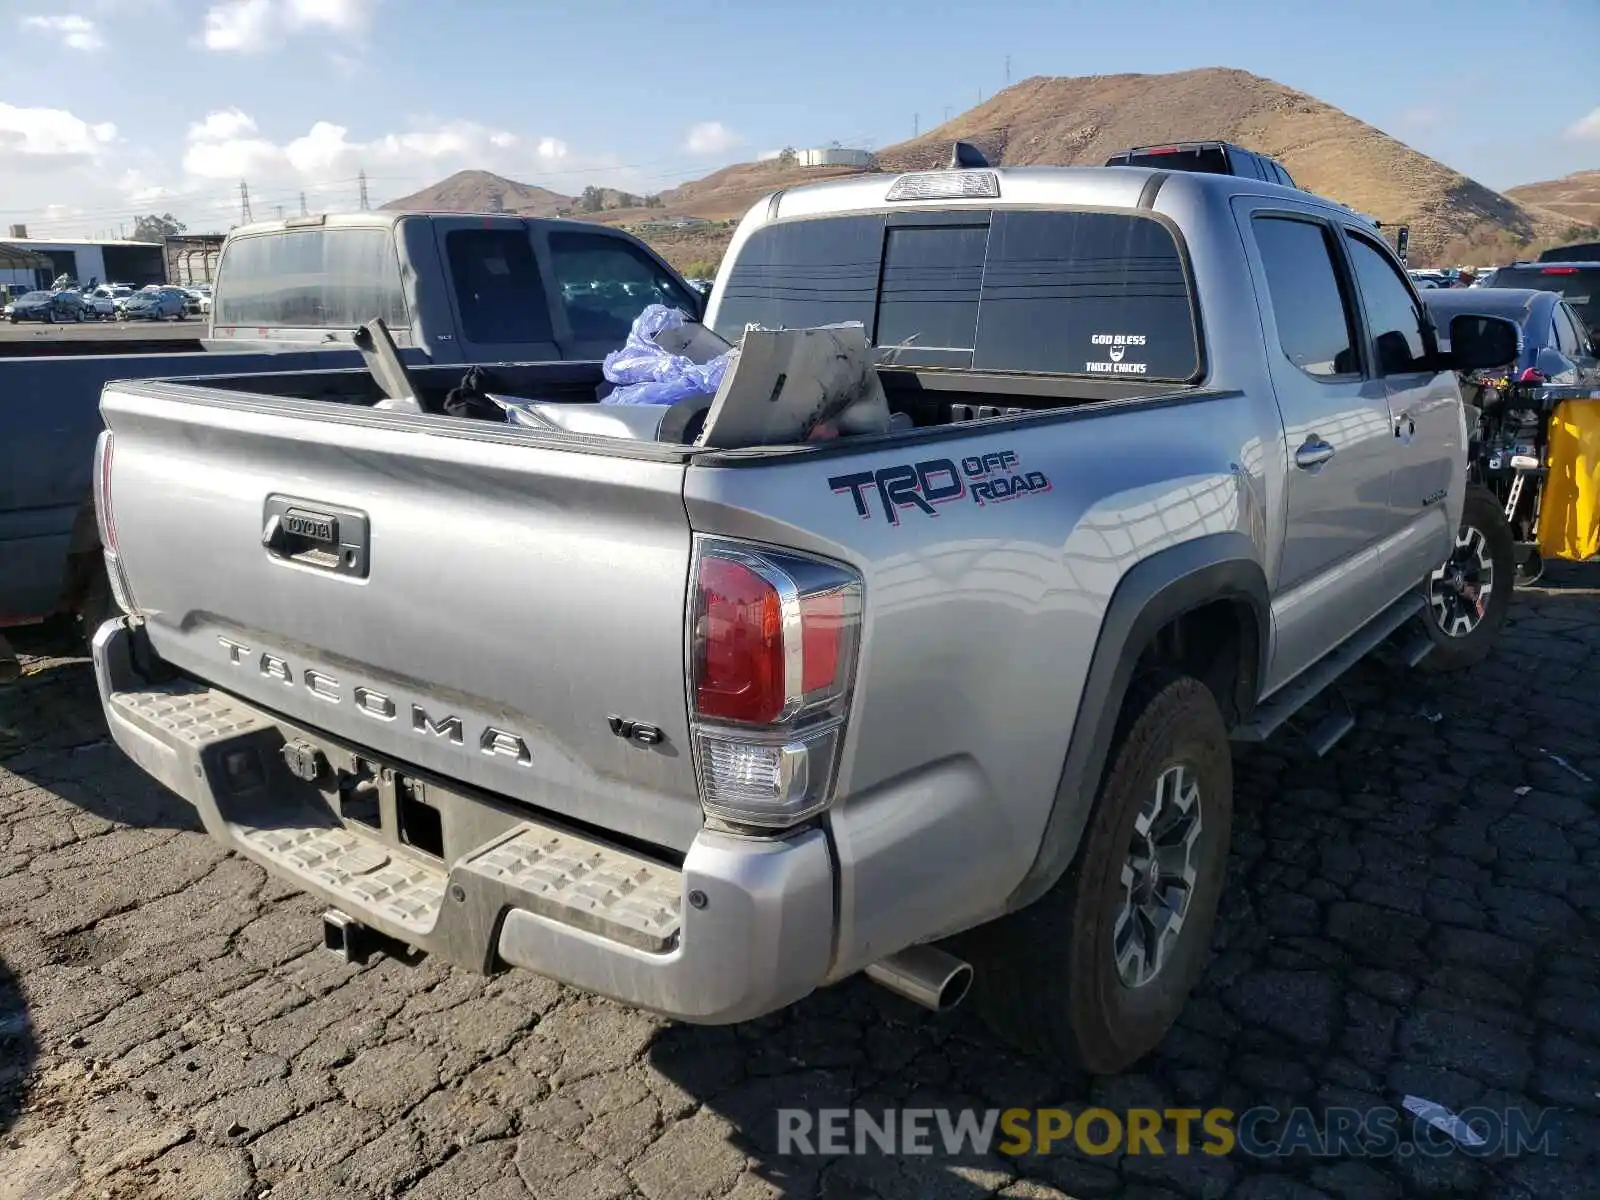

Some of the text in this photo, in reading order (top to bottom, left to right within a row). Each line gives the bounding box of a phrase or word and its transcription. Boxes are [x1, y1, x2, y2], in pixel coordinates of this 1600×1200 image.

[1091, 334, 1146, 346] GOD BLESS
[1113, 363, 1147, 373] CHICKS
[828, 450, 1019, 526] TRD OFF
[969, 471, 1053, 507] ROAD
[286, 519, 332, 539] TOYOTA
[217, 634, 534, 767] TACOMA
[607, 716, 664, 745] V6
